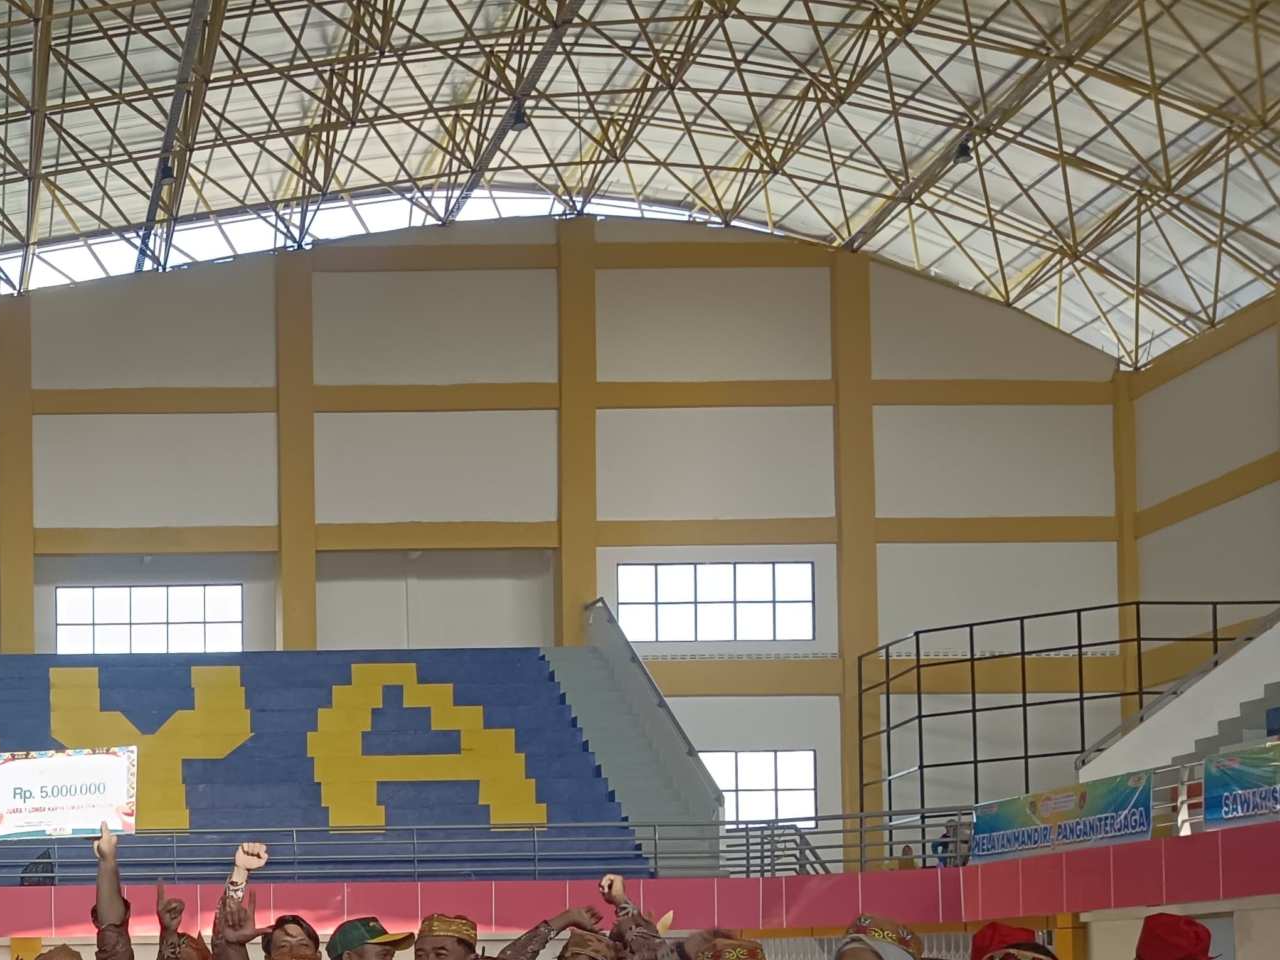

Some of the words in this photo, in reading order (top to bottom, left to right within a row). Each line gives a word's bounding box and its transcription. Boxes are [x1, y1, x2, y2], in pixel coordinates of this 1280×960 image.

[13, 787, 35, 803] Rp.
[40, 782, 106, 798] 5.000.000
[1222, 789, 1269, 818] SAWAH
[1056, 819, 1096, 842] PANGAN
